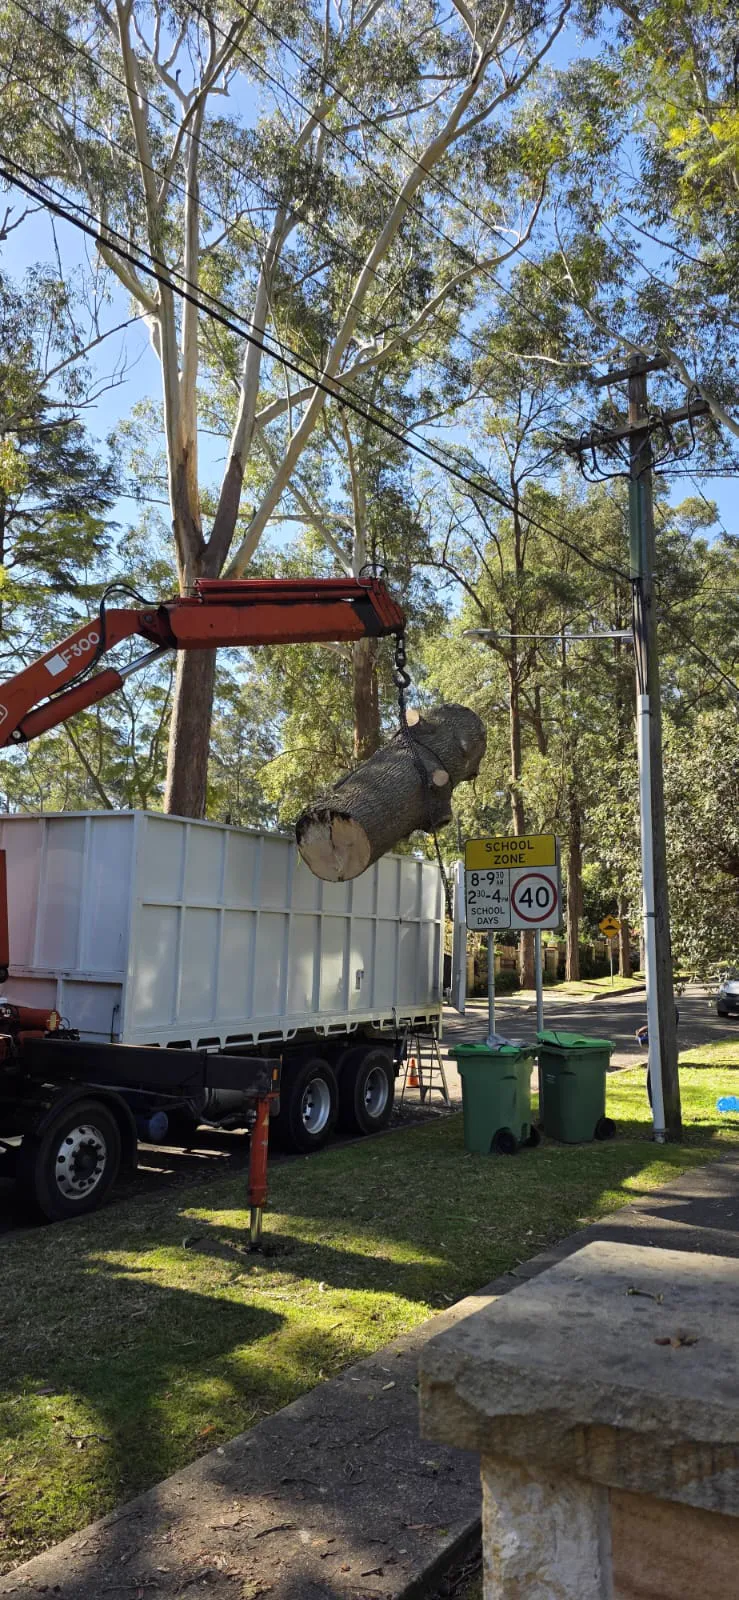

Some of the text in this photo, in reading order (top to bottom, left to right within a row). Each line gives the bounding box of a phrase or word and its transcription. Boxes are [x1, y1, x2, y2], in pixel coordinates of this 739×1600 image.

[61, 632, 100, 664] F300
[485, 840, 534, 852] SCHOOL
[494, 854, 526, 864] ZONE
[519, 886, 550, 908] 40
[471, 906, 505, 916] SCHOOL
[477, 916, 499, 925] DAYS
